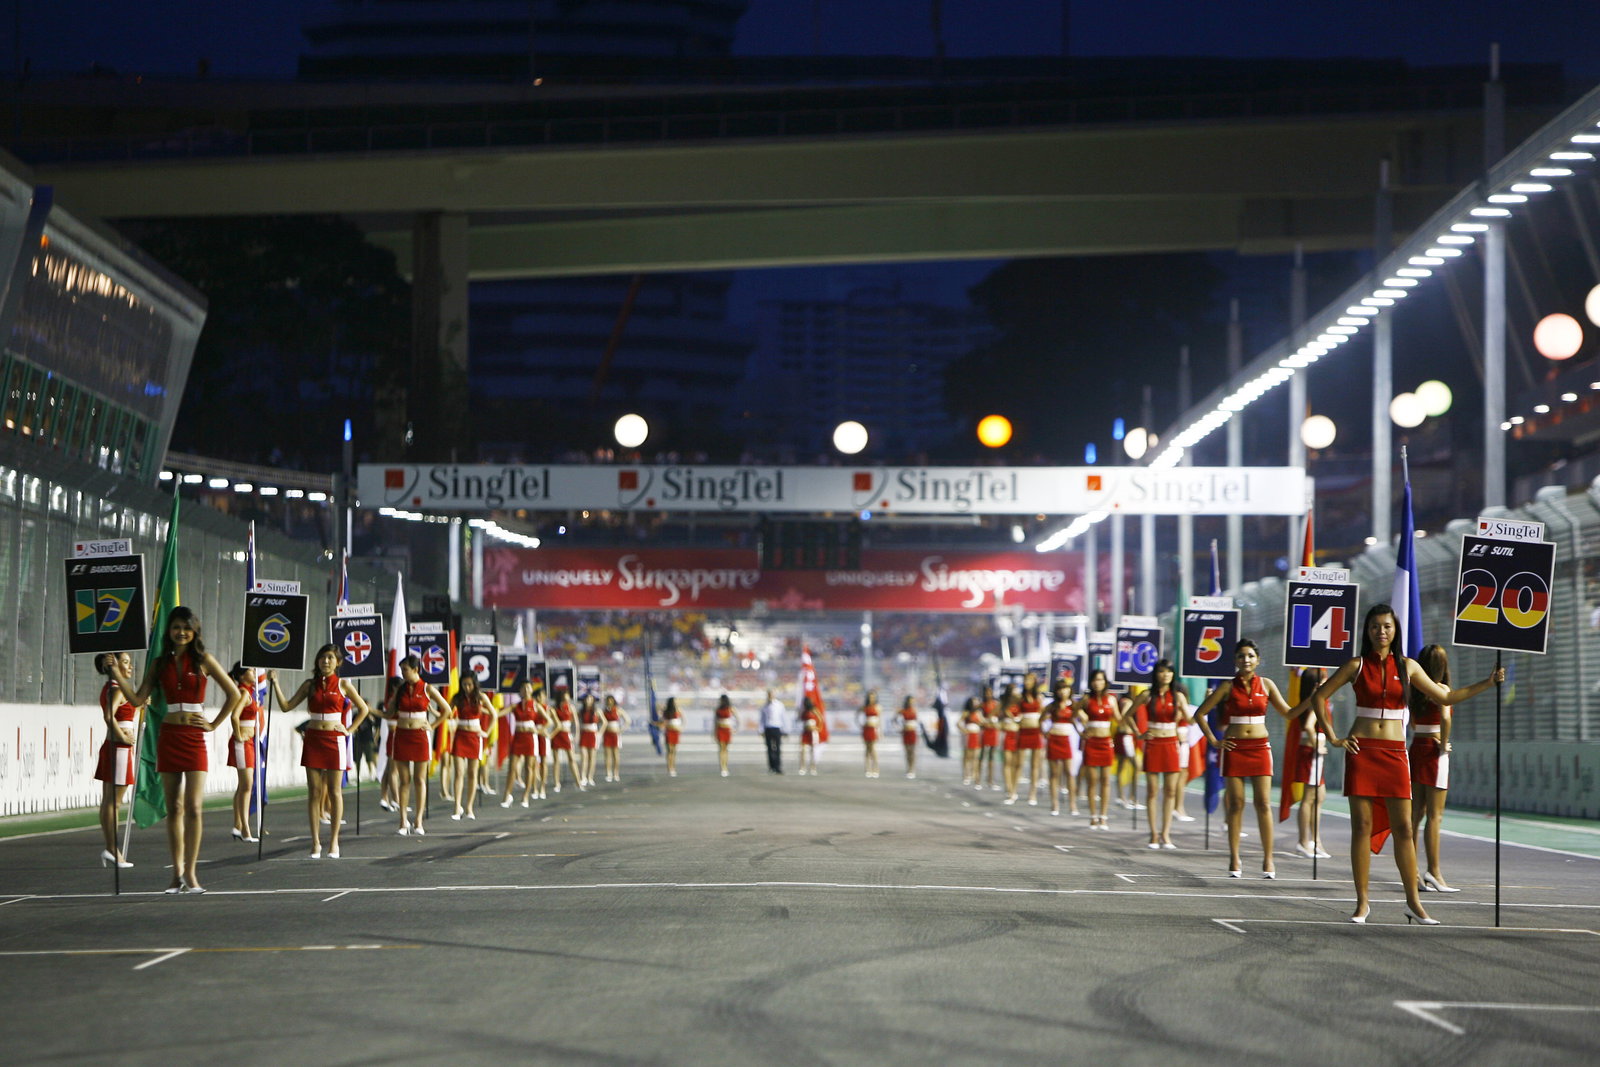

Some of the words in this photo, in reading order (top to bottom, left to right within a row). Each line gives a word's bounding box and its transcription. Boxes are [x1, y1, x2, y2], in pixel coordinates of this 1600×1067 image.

[428, 467, 550, 509] SingTel
[662, 468, 784, 510] SingTel
[896, 470, 1018, 512] SingTel
[1129, 472, 1251, 513] SingTel
[90, 542, 128, 554] SingTel
[1495, 523, 1540, 539] SingTel
[1490, 546, 1515, 556] SUTIL
[267, 583, 298, 594] SingTel
[522, 569, 614, 586] UNIQUELY
[618, 554, 760, 607] Singapore
[921, 555, 1066, 608] Singapore
[1312, 569, 1347, 582] SingTel
[75, 587, 137, 634] 17
[265, 598, 288, 606] PIQUET
[347, 605, 373, 615] SingTel
[1456, 568, 1549, 629] 20
[258, 612, 292, 653] 6
[1195, 626, 1225, 663] 5
[1291, 604, 1350, 650] 14
[344, 630, 372, 666] 9
[1117, 640, 1159, 675] 10
